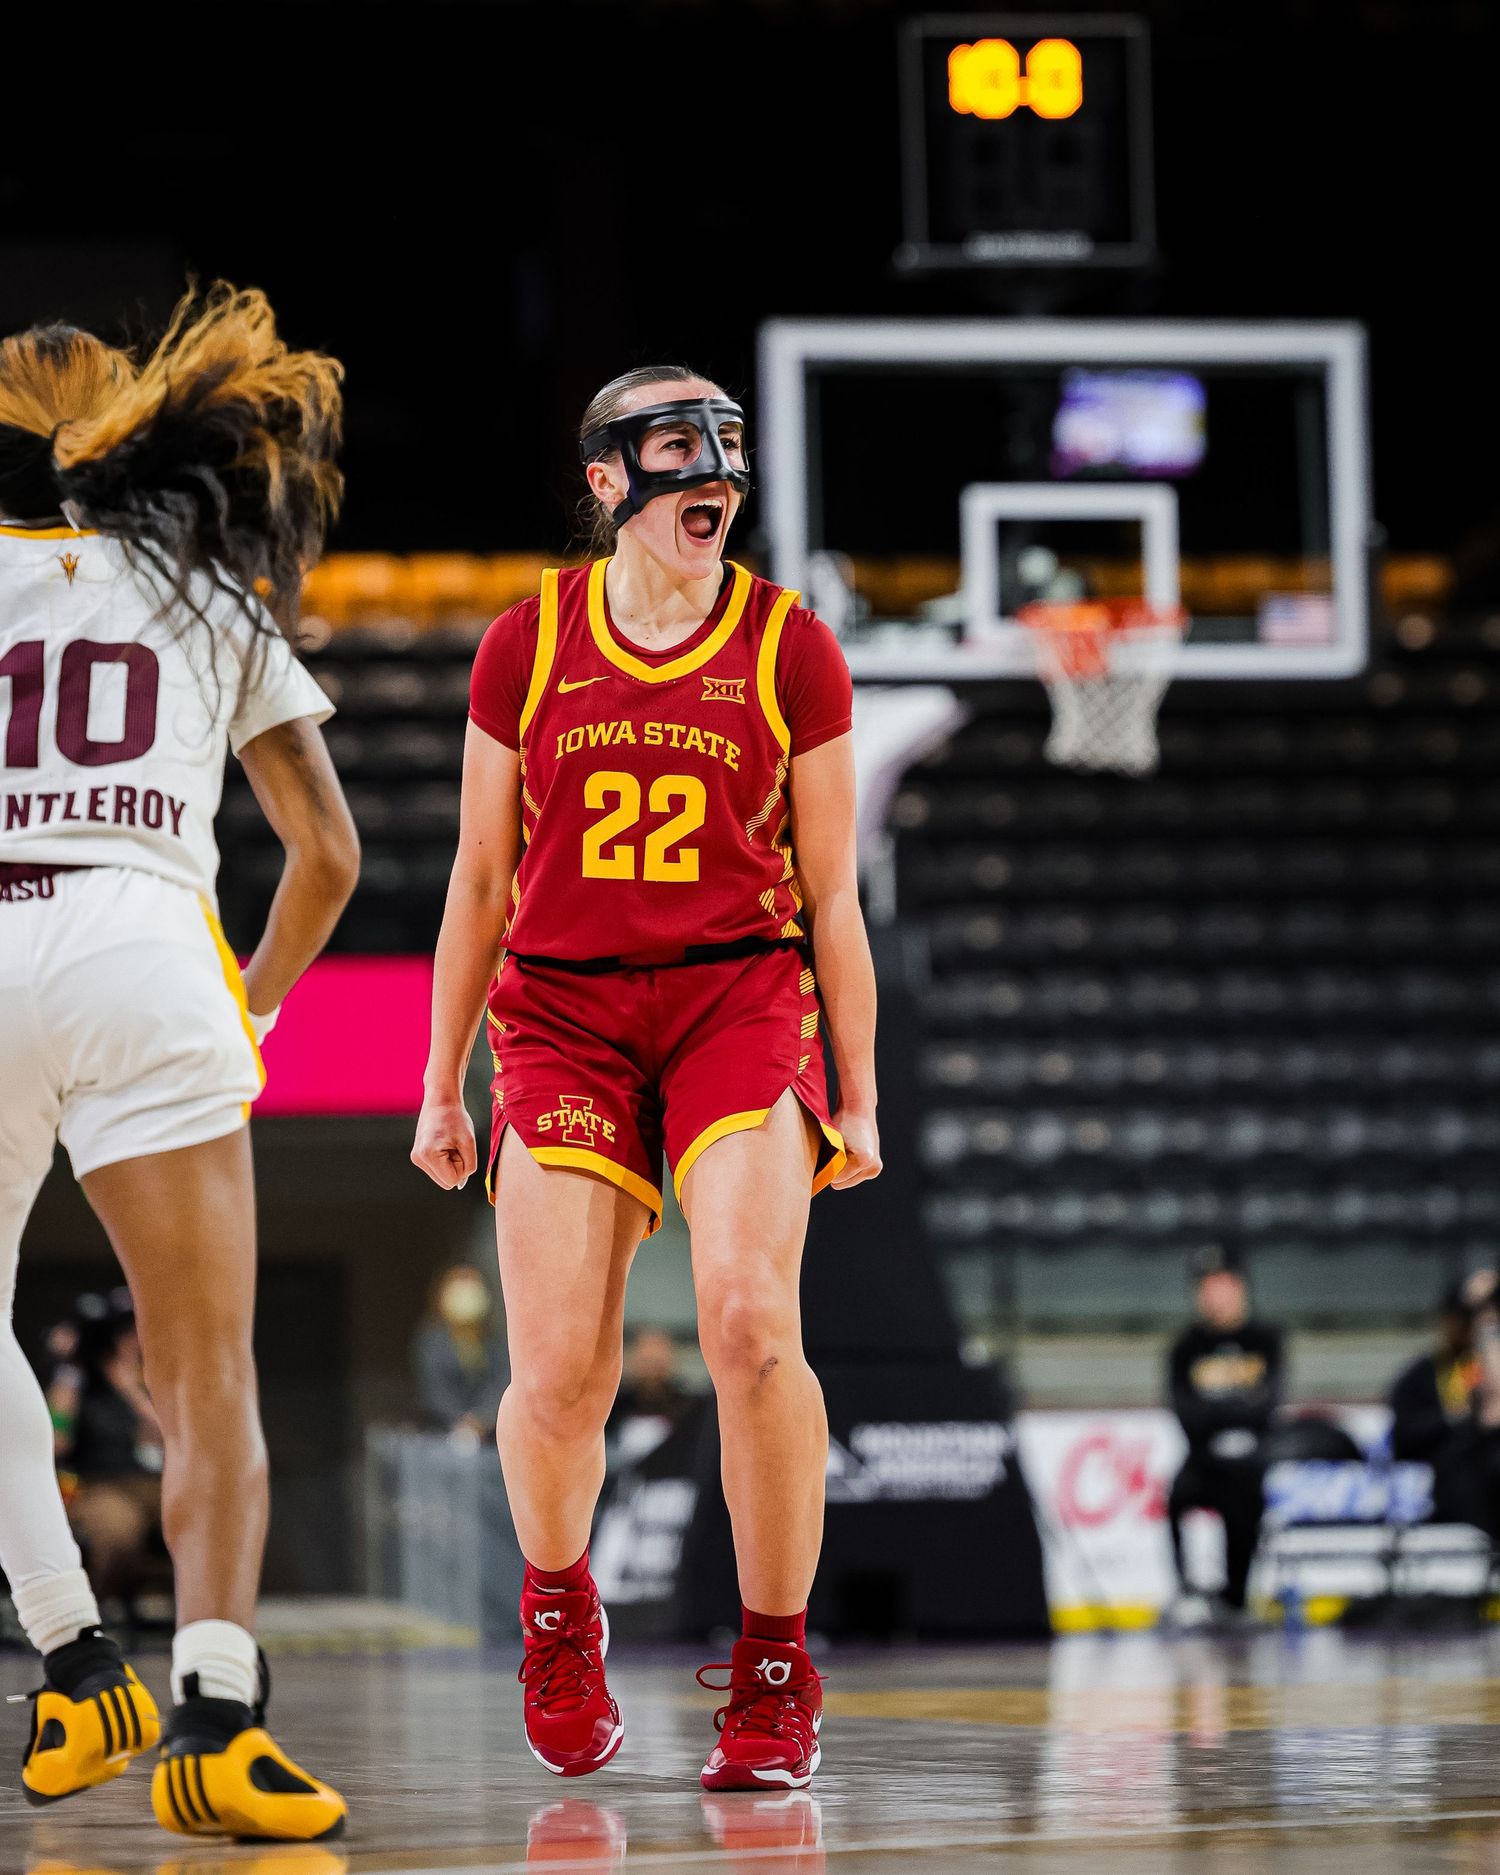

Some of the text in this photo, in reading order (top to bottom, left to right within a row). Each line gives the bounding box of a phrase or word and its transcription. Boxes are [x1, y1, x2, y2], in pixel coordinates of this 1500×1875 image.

[0, 639, 160, 768] 10
[708, 681, 739, 698] XII
[555, 720, 742, 772] IOWA STATE
[582, 770, 707, 882] 22
[536, 1108, 617, 1143] STATE
